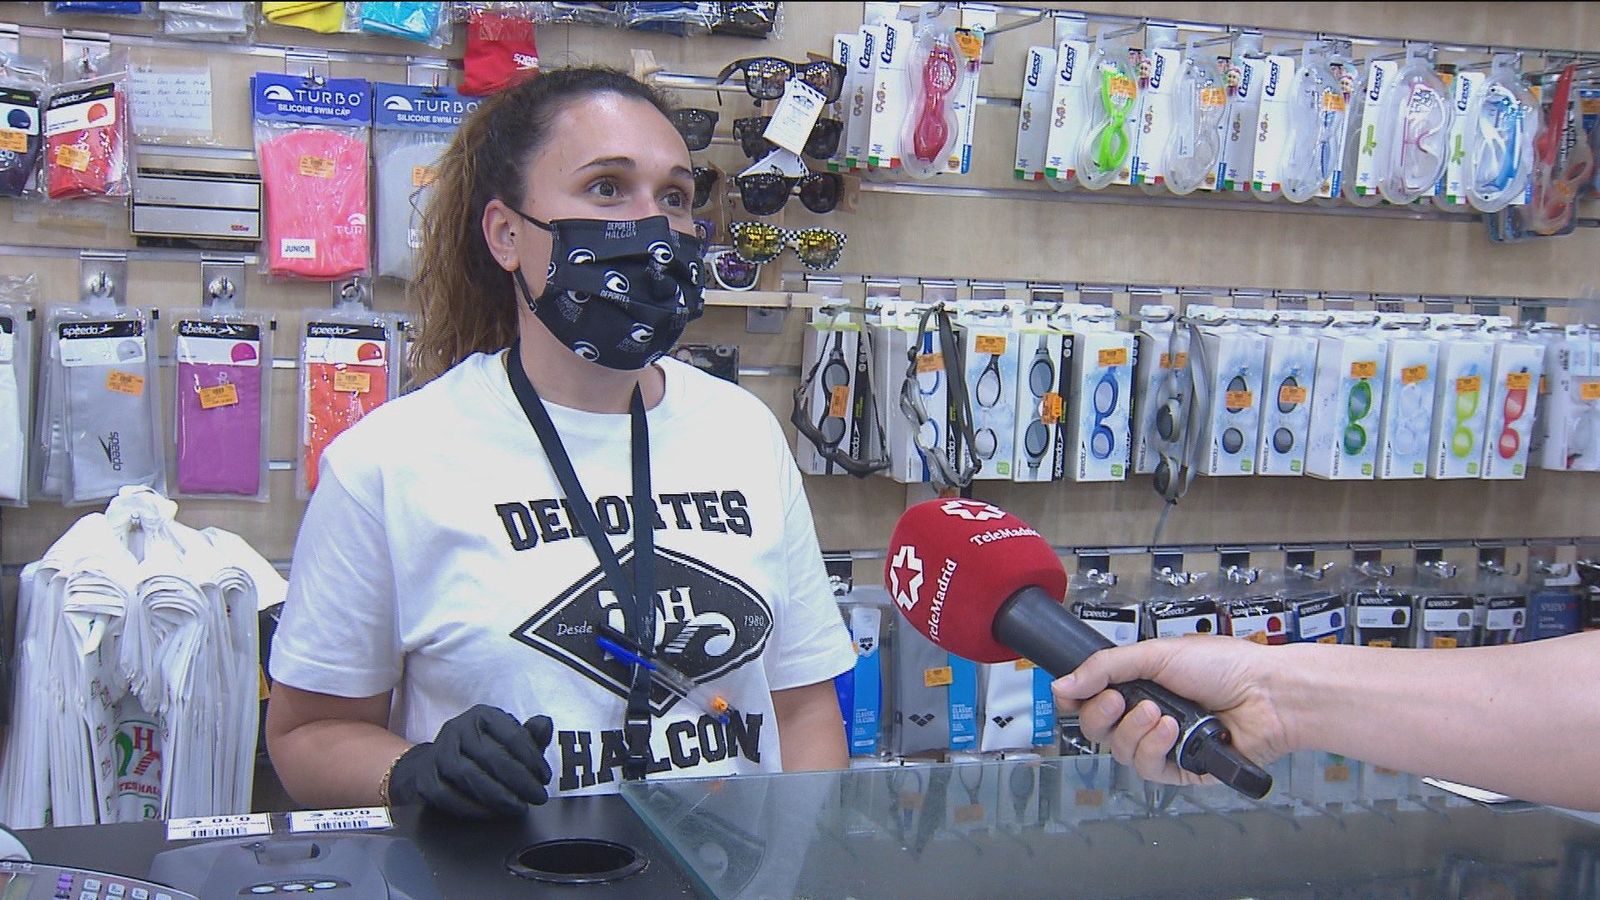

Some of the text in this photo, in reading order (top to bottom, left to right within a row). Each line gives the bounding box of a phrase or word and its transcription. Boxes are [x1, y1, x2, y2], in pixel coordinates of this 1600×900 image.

[859, 29, 873, 69] Cressi
[880, 23, 895, 64] Cressi
[1027, 50, 1041, 87] Cressi
[1060, 43, 1076, 82] Cressi
[1150, 51, 1164, 89] Cressi
[1238, 61, 1252, 98] Cressi
[1265, 59, 1279, 97] Cressi
[294, 89, 361, 106] TURBO
[1369, 65, 1384, 102] Cressi
[1457, 75, 1470, 111] Cressi
[278, 103, 351, 116] SILICONE SWIM CAP
[397, 113, 431, 123] SILICONE
[432, 115, 452, 124] SWIM
[605, 229, 637, 239] HALCON
[607, 222, 636, 231] DEPORTES
[285, 245, 311, 253] JUNIOR
[62, 325, 99, 338] speedo
[310, 326, 344, 336] speedo
[109, 431, 123, 471] speedo
[1054, 442, 1064, 478] speedo
[928, 558, 957, 642] TeleMadrid
[1082, 609, 1108, 620] speedo
[557, 620, 593, 636] Desde
[743, 615, 765, 628] 1980
